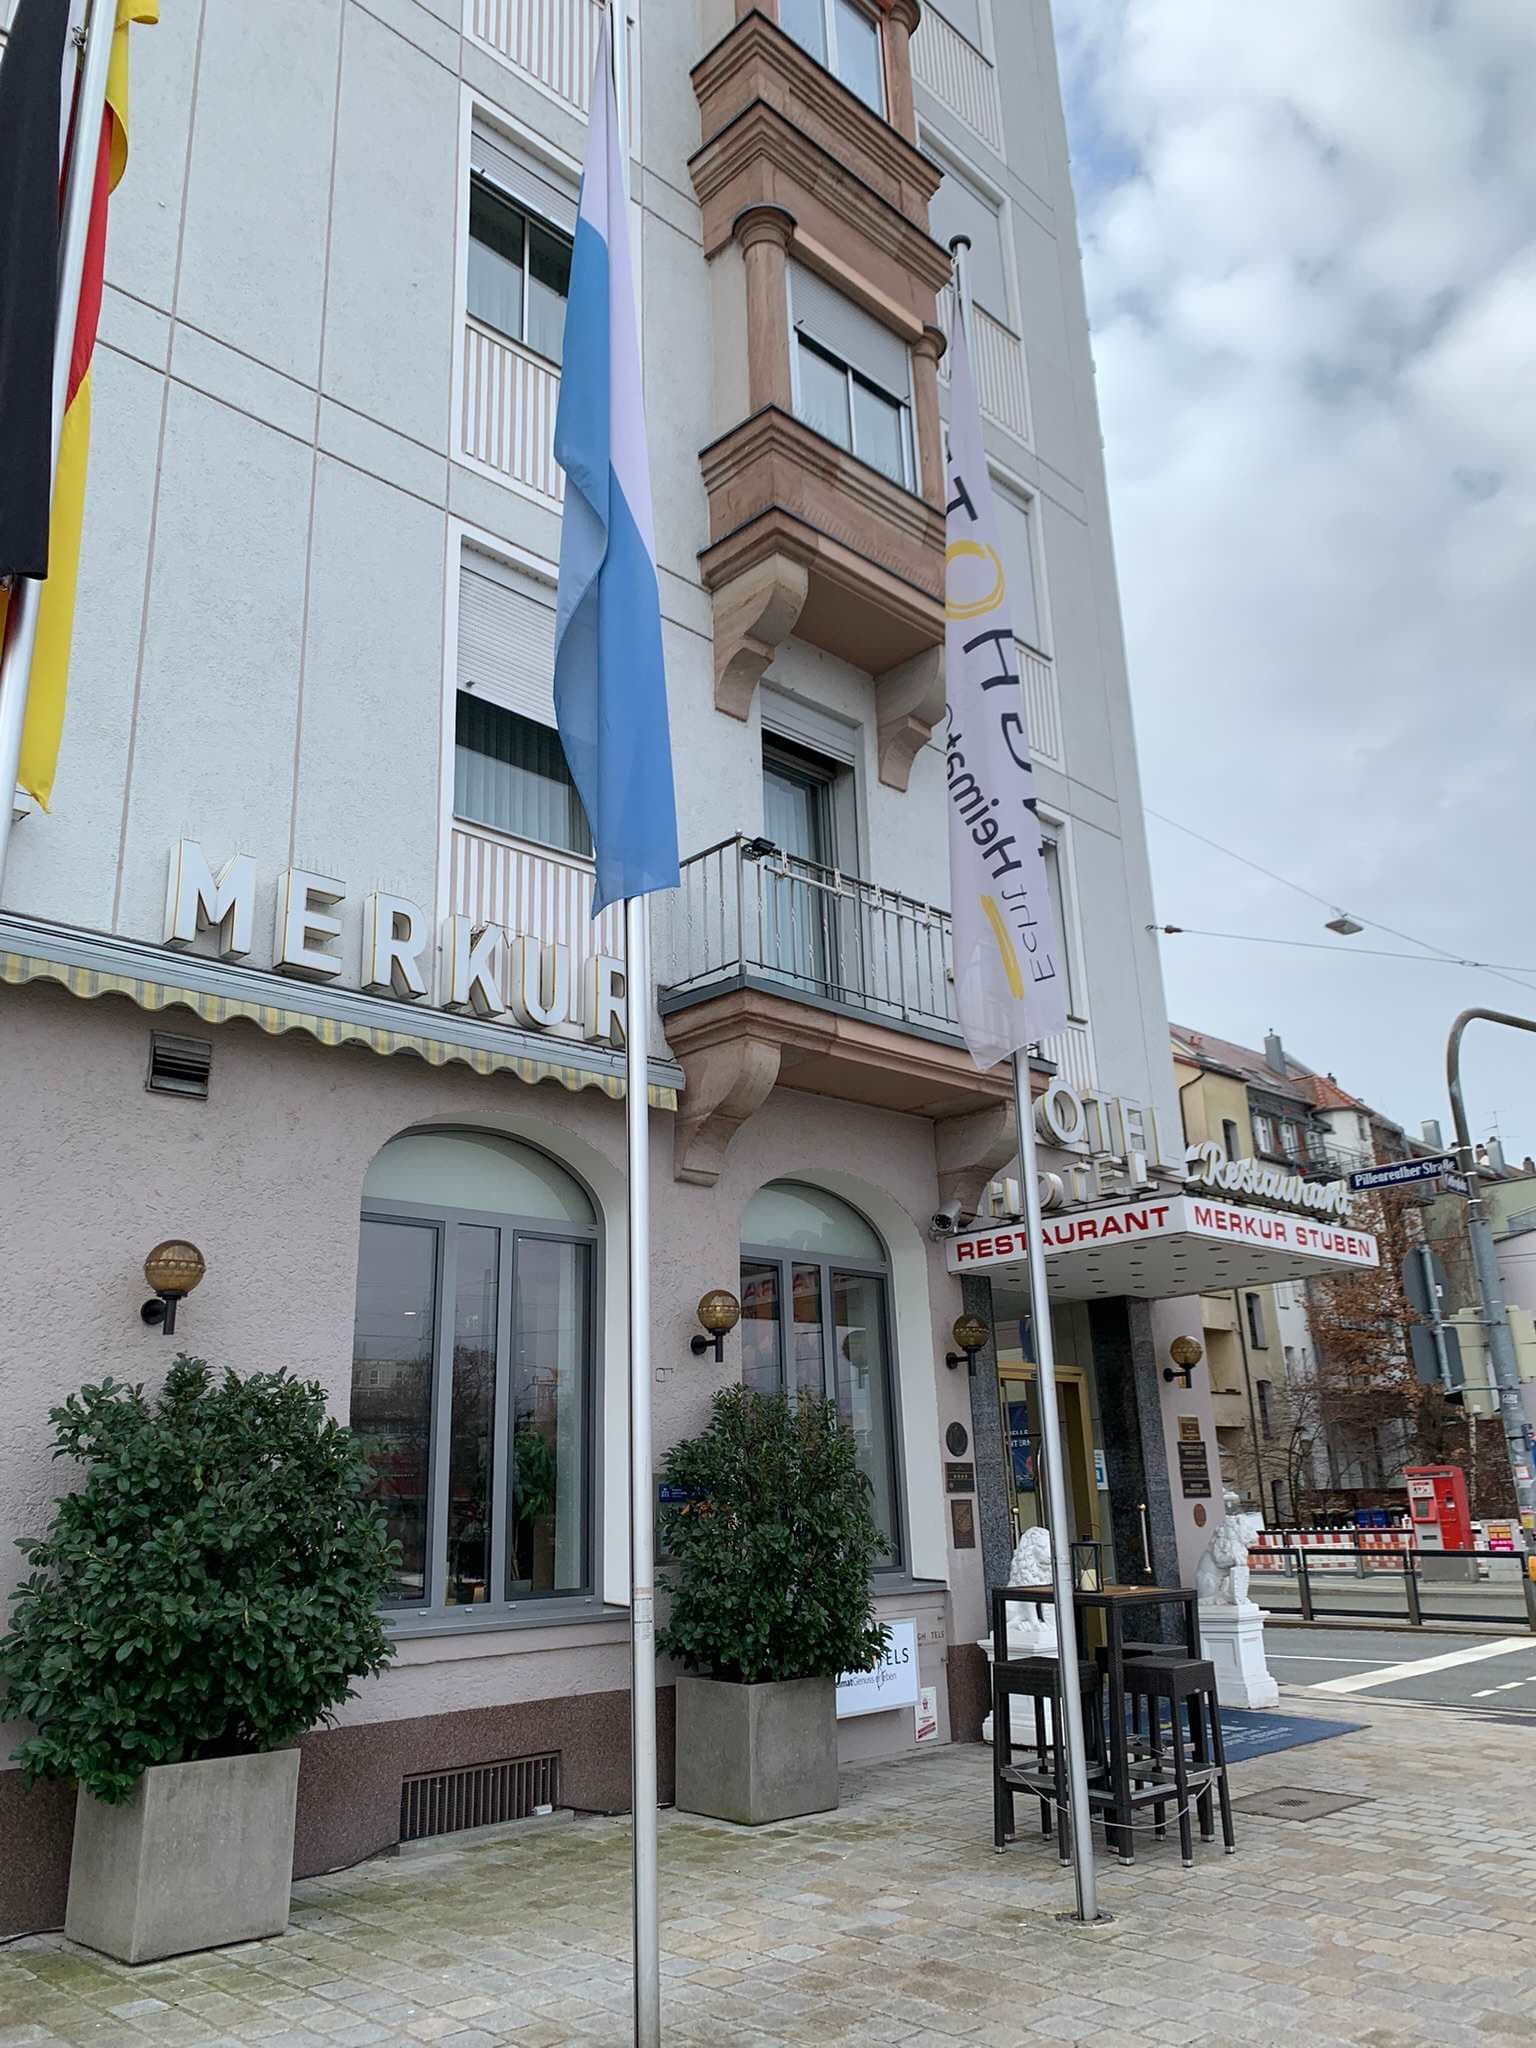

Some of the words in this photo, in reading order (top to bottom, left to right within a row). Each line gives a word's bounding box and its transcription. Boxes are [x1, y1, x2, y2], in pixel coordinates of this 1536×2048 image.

[163, 838, 626, 1048] MERKUR
[1033, 1079, 1181, 1173] OTEL
[1184, 1141, 1353, 1216] Restaurant
[1194, 1206, 1287, 1242] MERKUR
[1296, 1226, 1371, 1257] STUBEN
